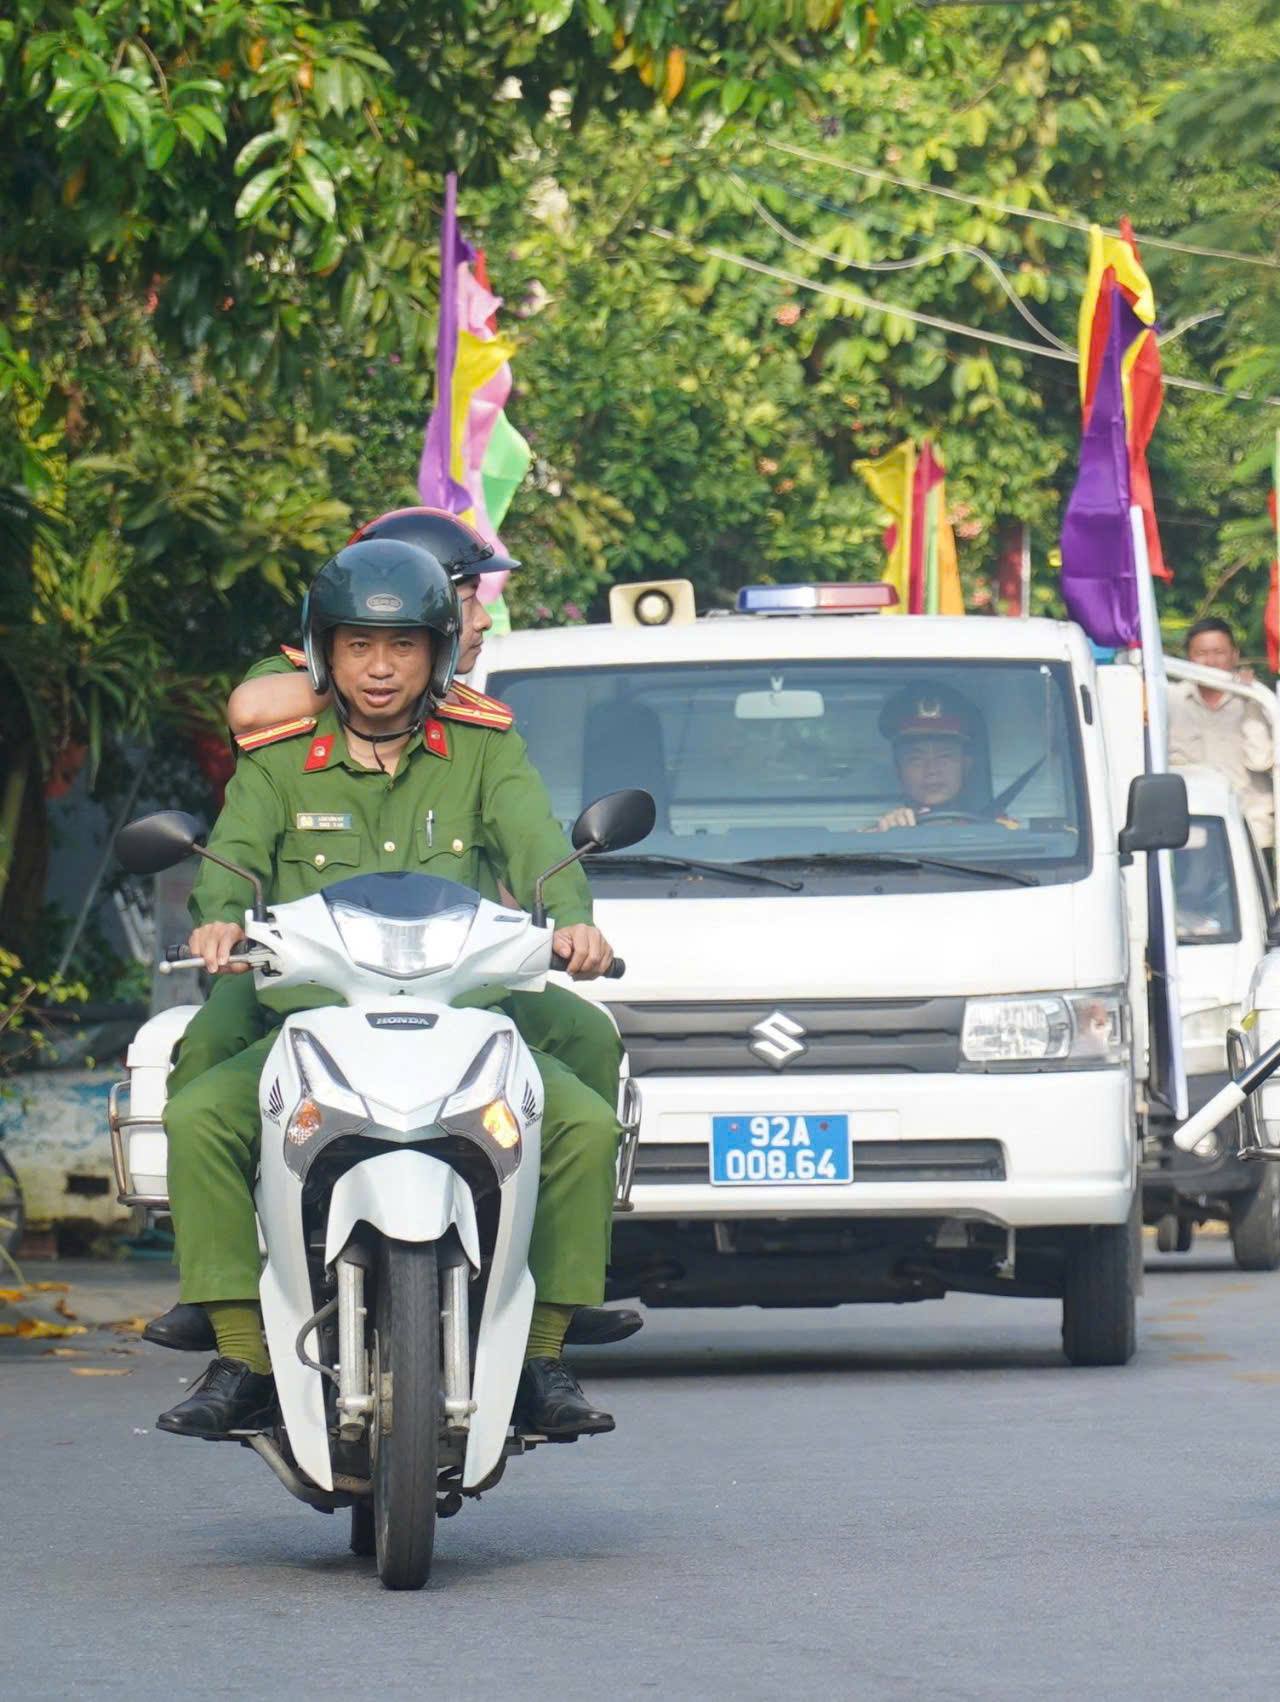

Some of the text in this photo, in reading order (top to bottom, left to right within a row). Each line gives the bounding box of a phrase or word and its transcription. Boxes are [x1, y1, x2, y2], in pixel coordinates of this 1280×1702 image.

[376, 1016, 430, 1026] HONDA
[750, 1116, 811, 1147] 92A
[726, 1148, 836, 1180] 008.64
